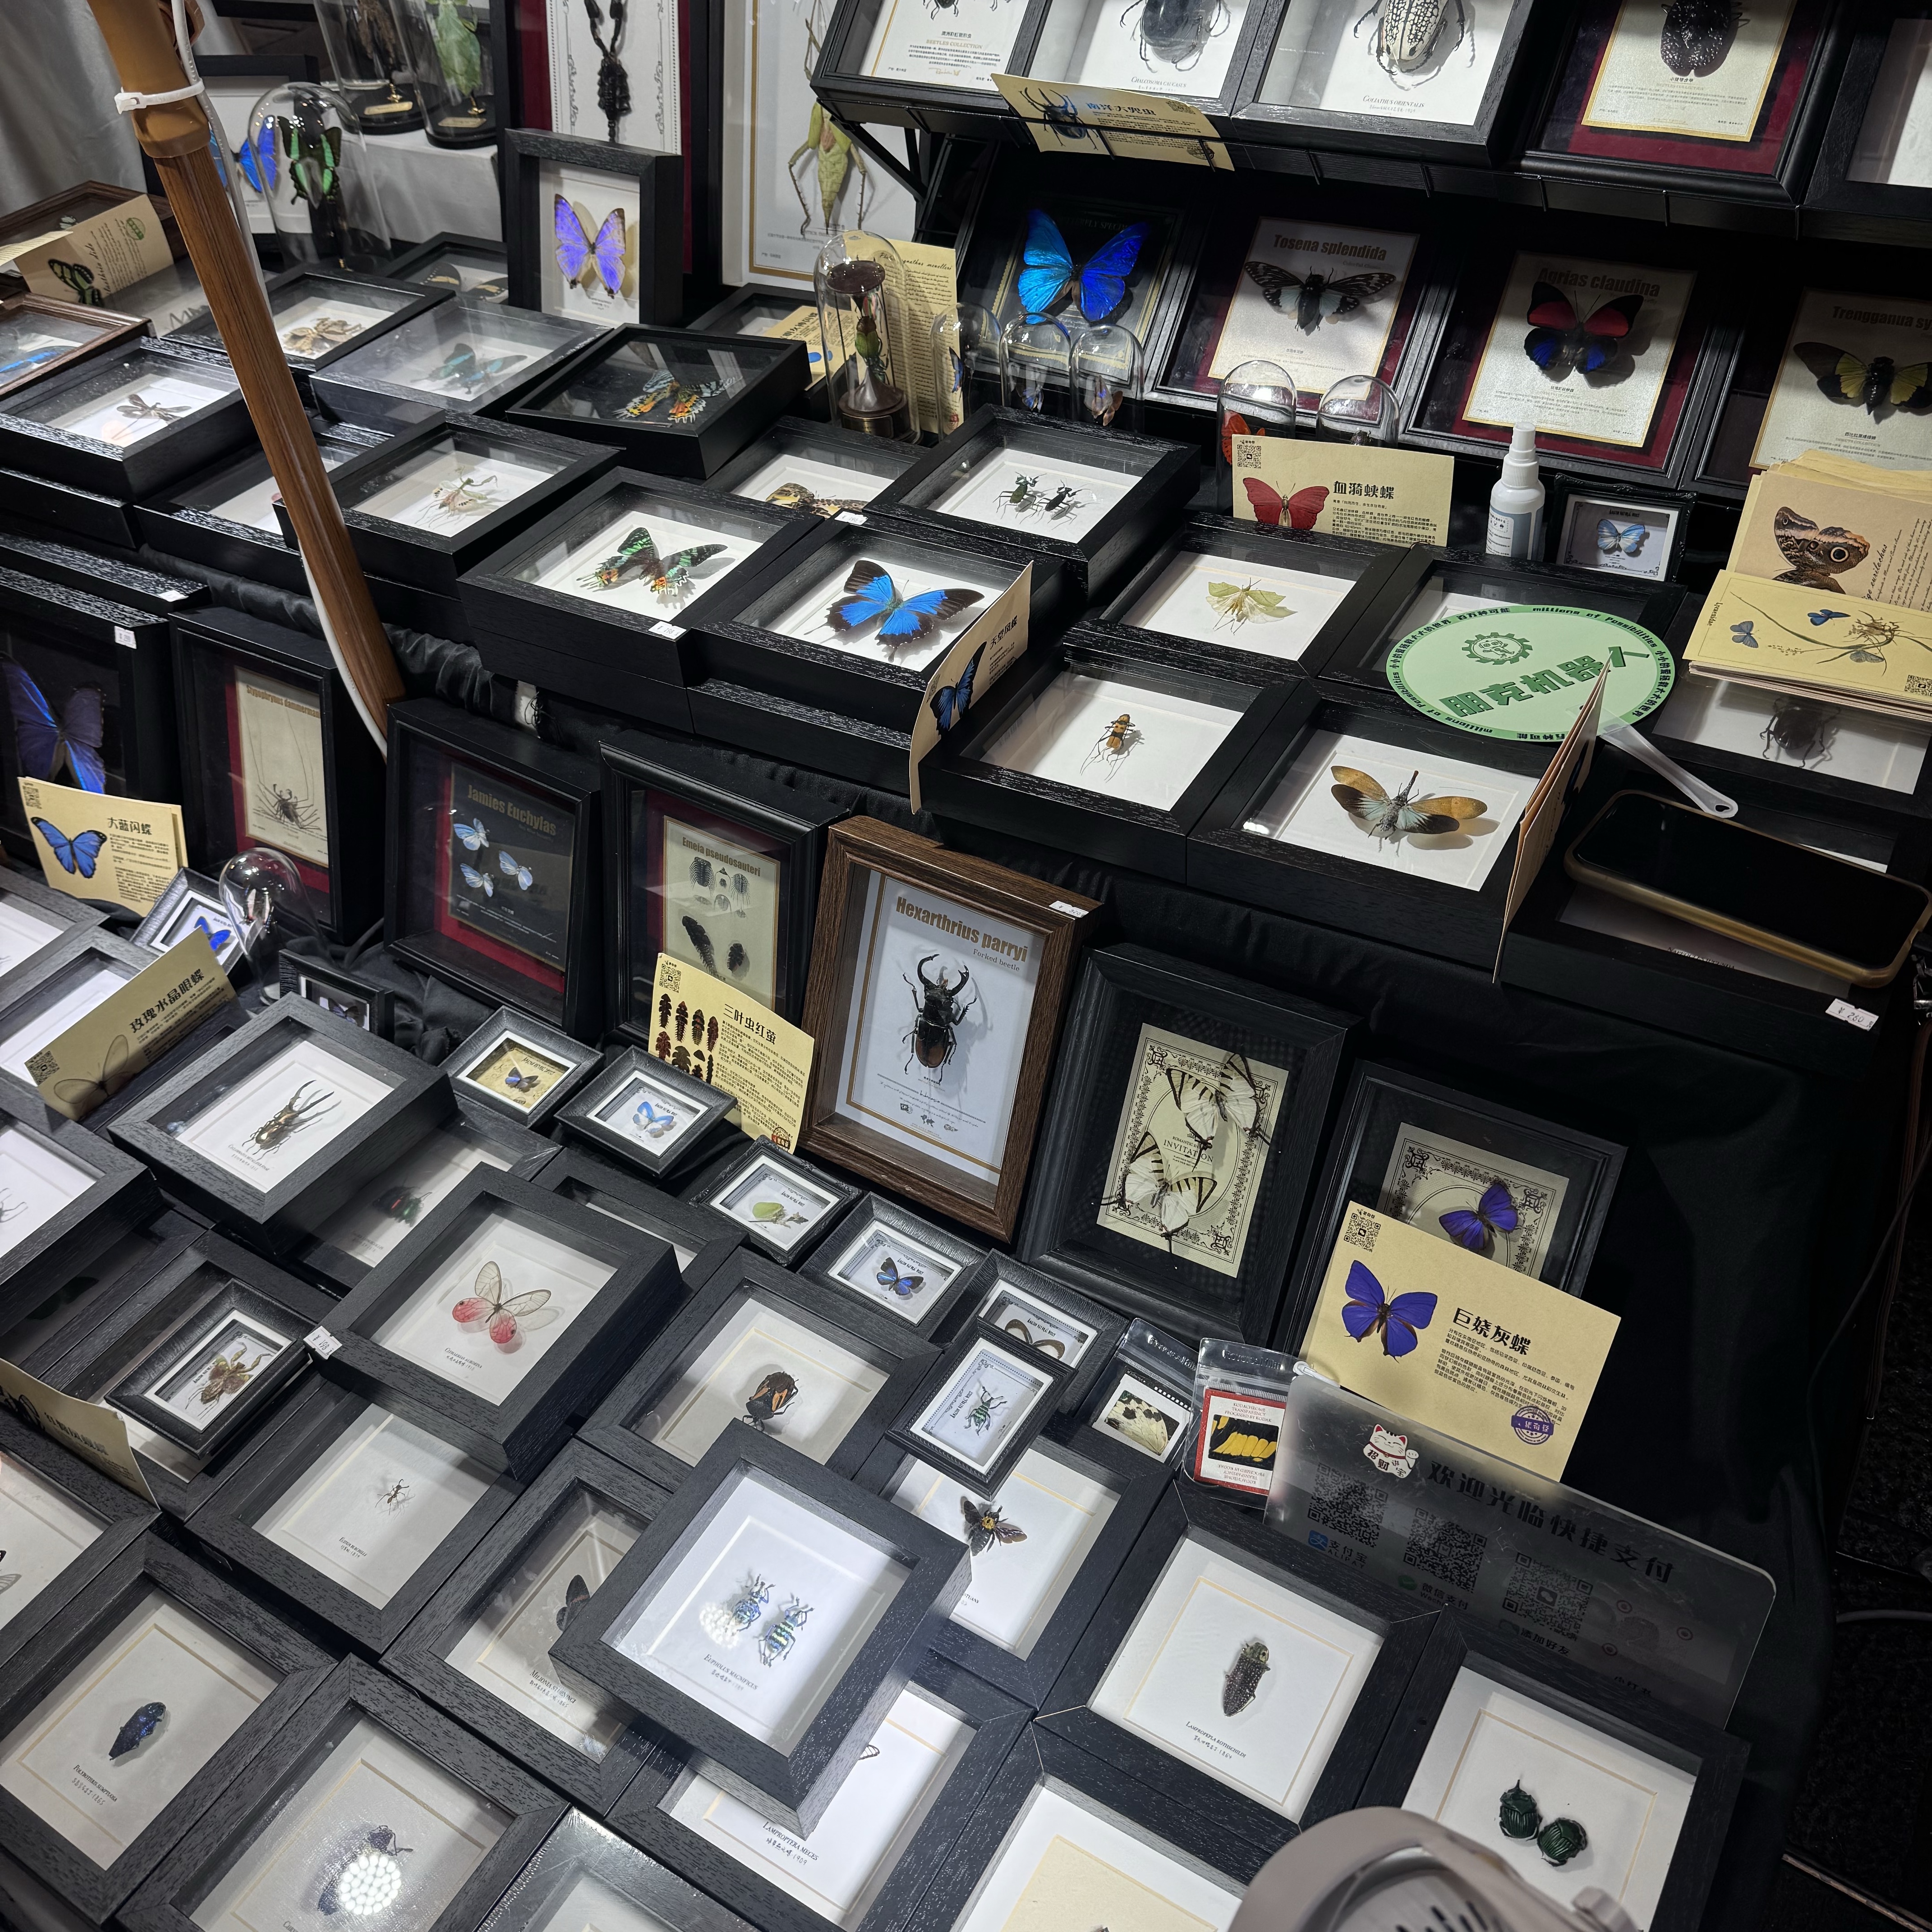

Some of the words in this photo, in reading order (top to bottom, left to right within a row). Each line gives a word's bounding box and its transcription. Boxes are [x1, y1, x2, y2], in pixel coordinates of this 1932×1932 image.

[1273, 234, 1319, 252] Tosena
[1321, 242, 1387, 261] splendida
[1590, 275, 1661, 297] claudina
[1832, 306, 1914, 327] Trengganua
[1915, 317, 1932, 331] sy
[1457, 607, 1510, 621] 百万种可能
[1532, 607, 1580, 615] millions
[1605, 616, 1657, 648] Possibilities
[1392, 672, 1426, 708] Possibilities
[1438, 646, 1650, 718] 朋克机器人
[1444, 716, 1493, 734] millions
[468, 784, 505, 814] Jamies
[506, 801, 557, 836] Euchylas
[107, 817, 152, 835] 大蓝闪蝶
[682, 836, 704, 854] Emeia
[705, 847, 761, 877] pseudosauteri
[895, 896, 980, 943] Hexarthrius
[981, 932, 1028, 962] parryi
[973, 948, 998, 964] Forked
[999, 958, 1020, 972] beetle
[129, 968, 205, 1034] 玫瑰水晶眼蝶
[723, 1003, 776, 1045] 三叶虫红萤
[1164, 1139, 1214, 1163] INVITATON
[1233, 1403, 1266, 1412] KODACHROME
[1427, 1459, 1675, 1584] 欢迎光临快捷支付
[1329, 1539, 1367, 1566] 支付宝
[1422, 1582, 1468, 1610] 微信支付
[1520, 1628, 1569, 1656] 添加好友
[529, 1670, 552, 1688] MILIONIA
[704, 1654, 729, 1673] EUPHOLUS
[729, 1670, 759, 1690] MAGNIFICUS
[763, 1822, 800, 1850] LAMPROPTERA
[800, 1847, 819, 1861] MEGES
